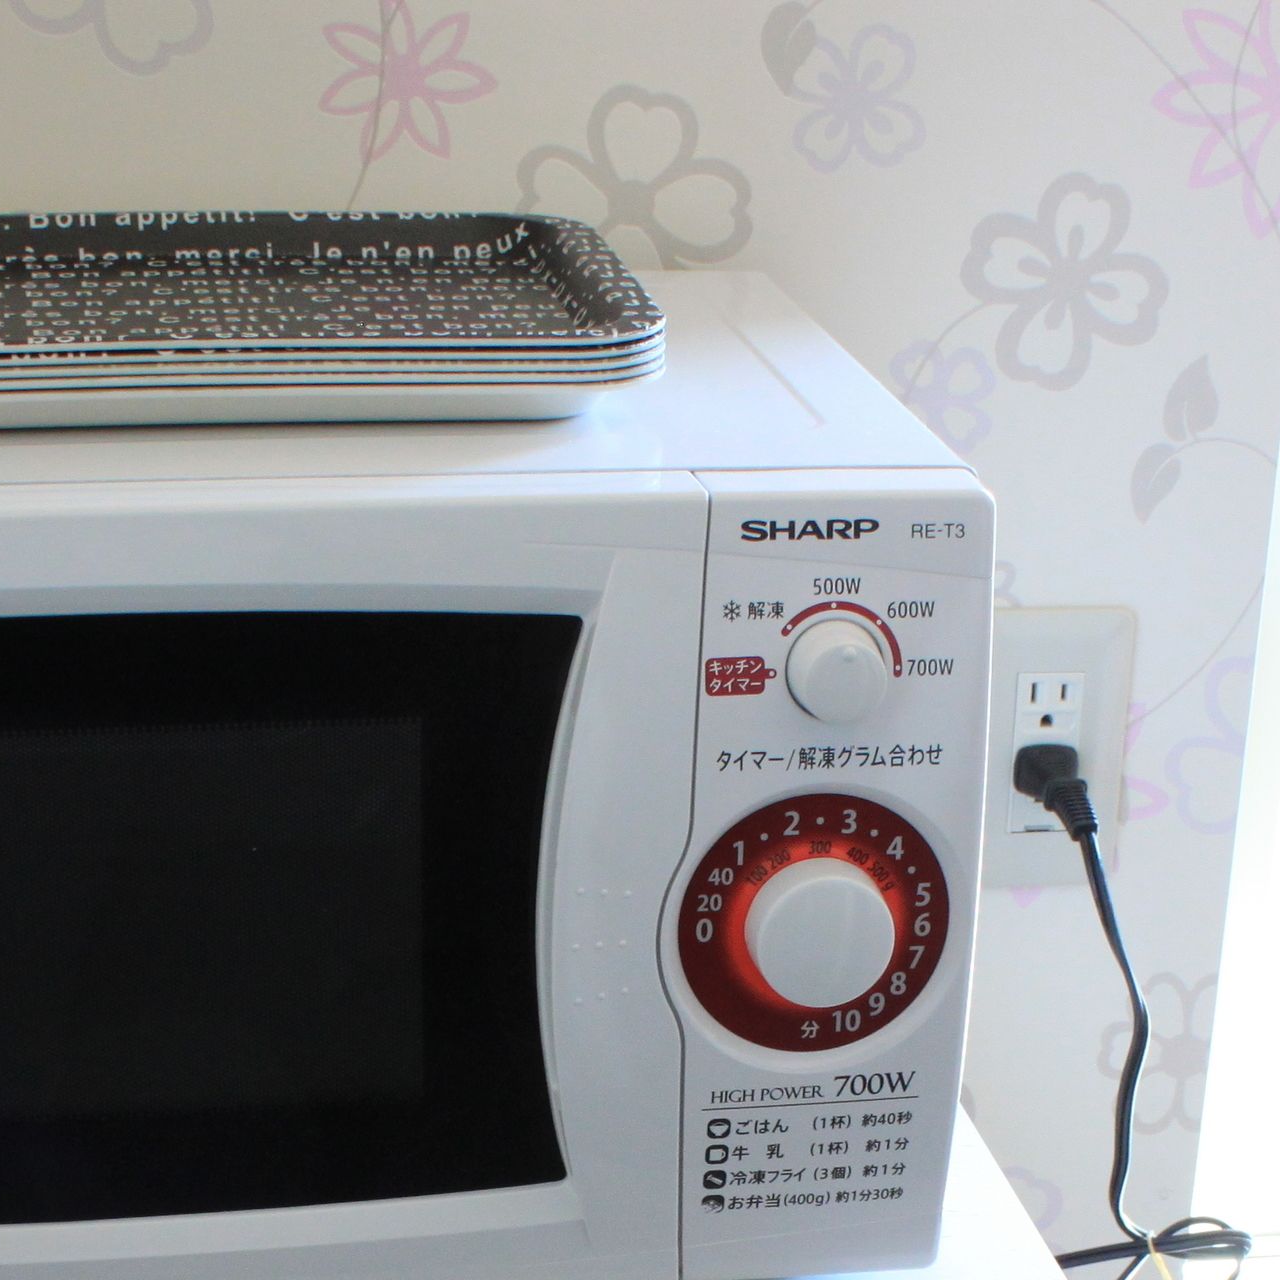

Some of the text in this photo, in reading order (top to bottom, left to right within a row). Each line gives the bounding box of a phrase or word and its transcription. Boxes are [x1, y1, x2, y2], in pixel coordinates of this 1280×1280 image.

[741, 519, 965, 542] SHARP RE-T3
[813, 577, 861, 596] 500W
[747, 601, 785, 620] 解凍
[887, 601, 936, 619] 600W
[709, 659, 763, 676] キッチン
[907, 659, 955, 677] 700W
[709, 678, 763, 694] タイマー
[808, 840, 832, 855] 300
[847, 845, 869, 866] 400
[696, 809, 931, 1032] 0 20 40 1 2 3 4 5 6 7 8 9 10
[801, 1020, 821, 1039] 分
[711, 1071, 917, 1104] HIGH POWER 700W
[735, 1119, 789, 1135] ごはん
[729, 1167, 807, 1186] 冷凍フライ
